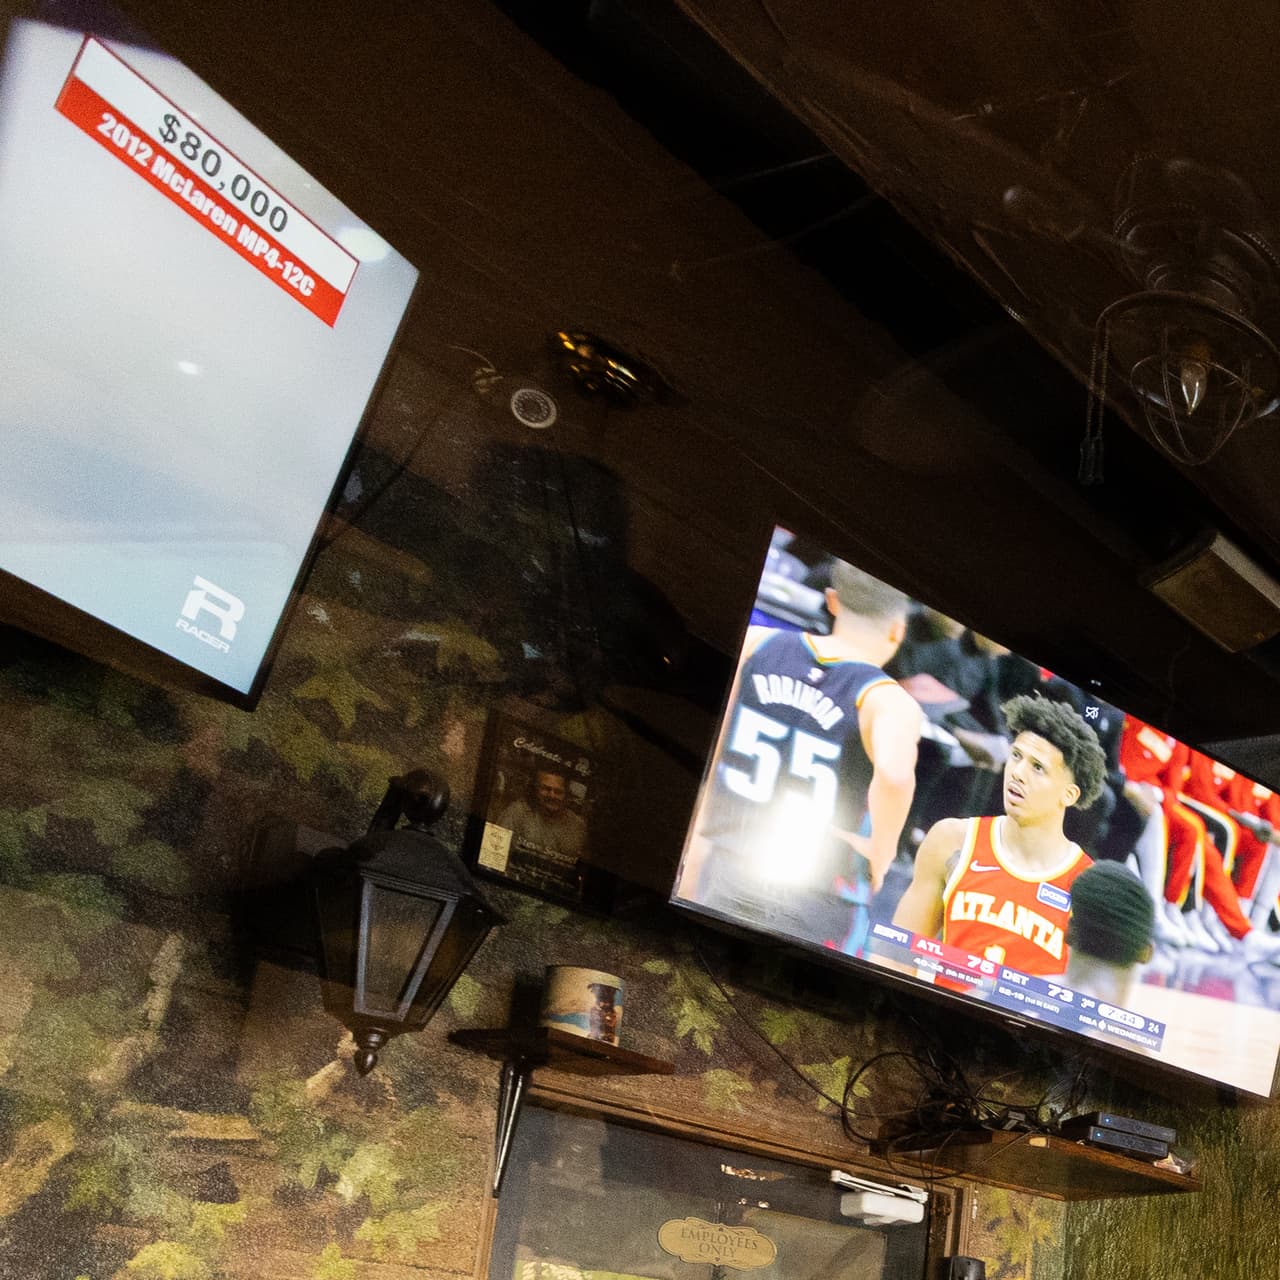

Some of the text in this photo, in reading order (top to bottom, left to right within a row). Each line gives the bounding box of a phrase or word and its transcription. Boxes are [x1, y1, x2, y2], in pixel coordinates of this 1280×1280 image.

[159, 113, 288, 233] $80,000
[97, 113, 316, 297] 2012 McLaren MP4-12C
[176, 618, 230, 654] RACER
[752, 674, 845, 731] ROBINSON
[724, 705, 842, 823] 55
[873, 923, 909, 943] ESPN
[950, 891, 1064, 960] ATLANTA
[916, 939, 995, 975] ATL 75
[1002, 969, 1029, 986] DET
[1047, 984, 1074, 1003] 73
[1147, 1022, 1160, 1034] 24
[1078, 1014, 1159, 1048] NBA WEDNESDAY
[681, 1228, 758, 1250] EMPLOYEES
[699, 1243, 737, 1259] ONLY
